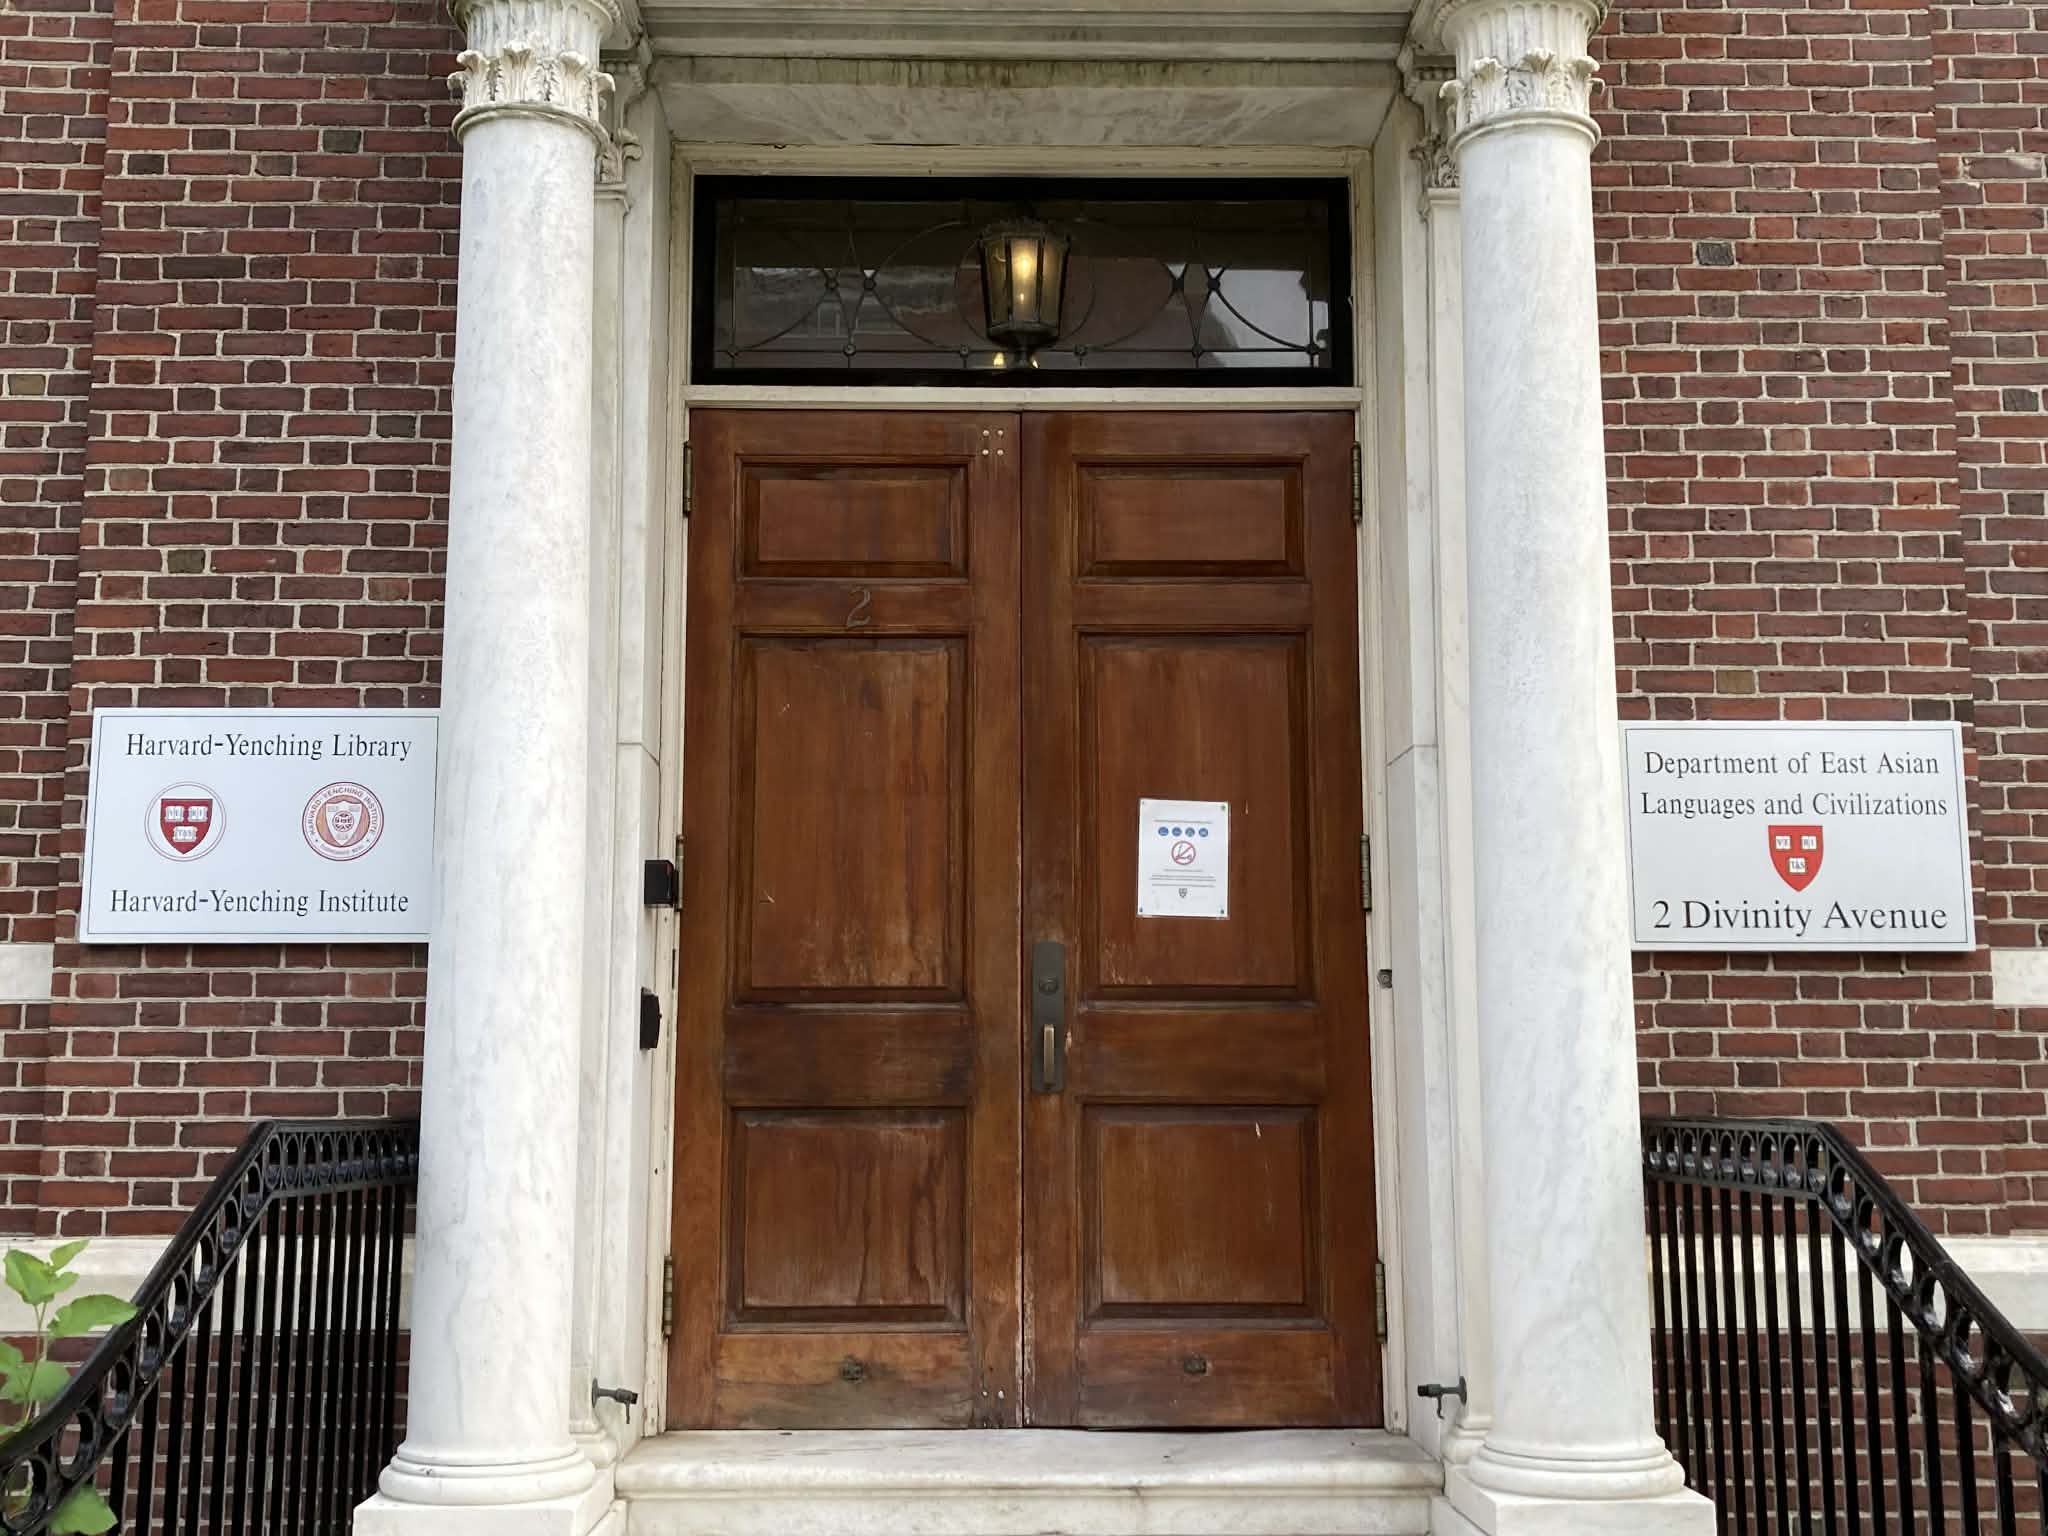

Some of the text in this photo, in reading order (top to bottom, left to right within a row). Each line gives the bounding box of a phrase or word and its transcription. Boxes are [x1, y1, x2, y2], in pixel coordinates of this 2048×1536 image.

[847, 584, 873, 629] 2
[125, 733, 413, 762] Harvard-Yenching Library
[1644, 751, 1940, 779] Department of East Asian
[1640, 791, 1948, 820] Languages and Civilizations
[111, 888, 409, 918] Harvard-Yenching Institute
[1652, 899, 1948, 936] 2 Divinity Avenue
